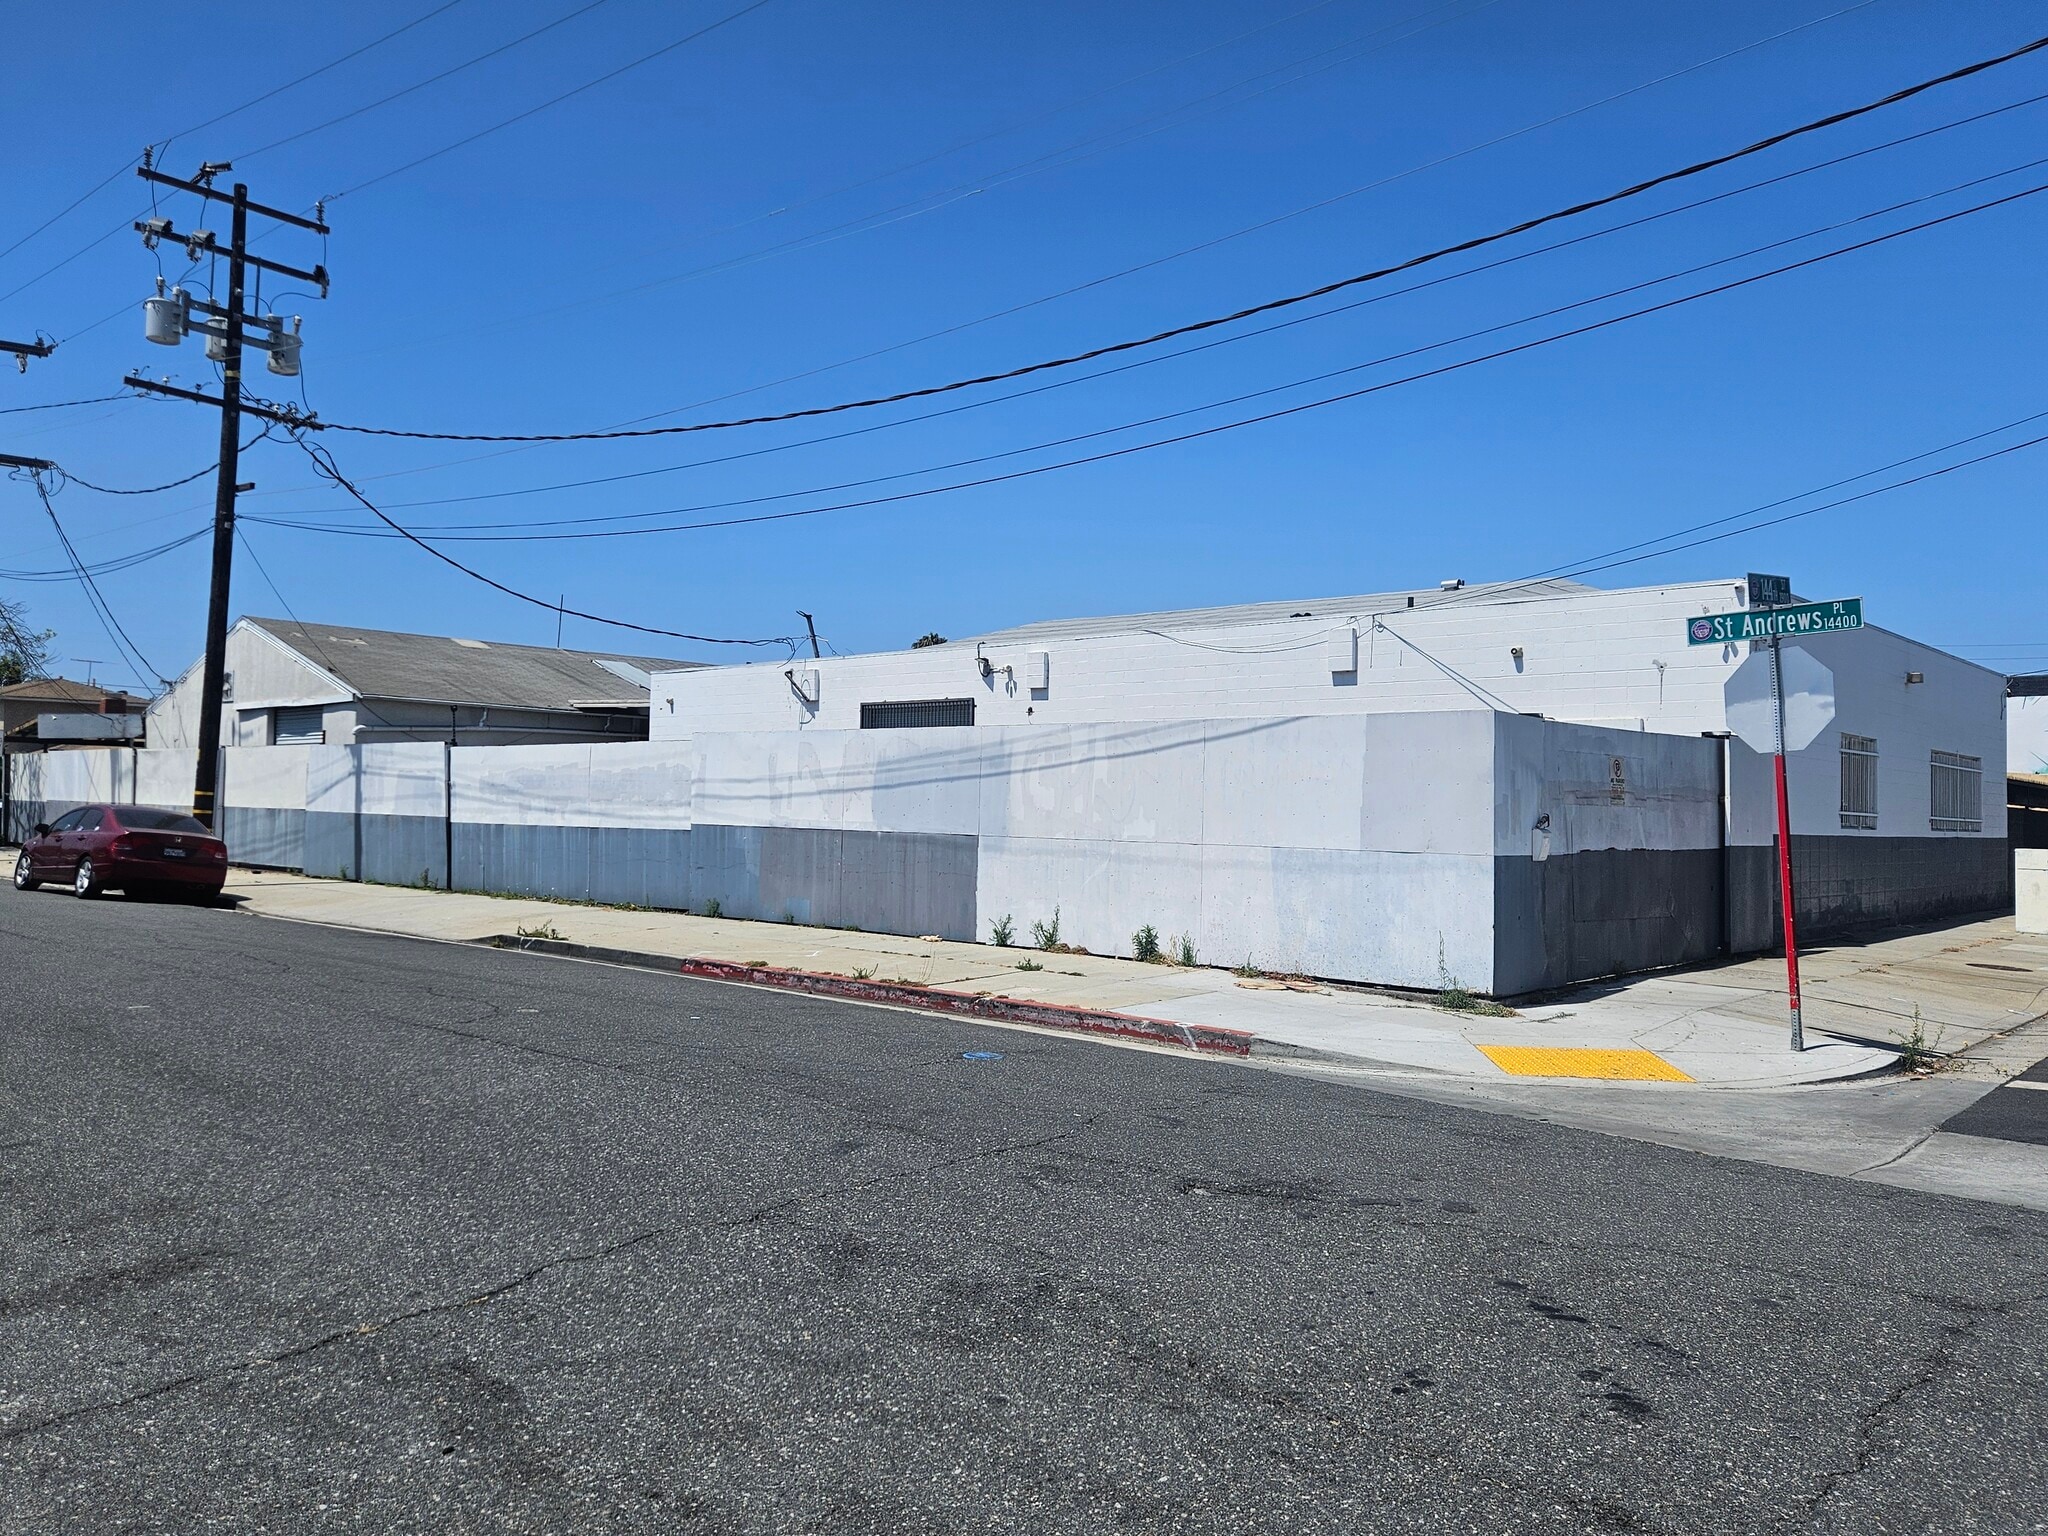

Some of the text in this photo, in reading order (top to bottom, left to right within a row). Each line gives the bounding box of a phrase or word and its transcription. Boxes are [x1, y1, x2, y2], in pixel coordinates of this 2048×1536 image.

[1833, 602, 1845, 614] PL
[1714, 618, 1733, 639] St
[1742, 612, 1822, 636] Andrews
[1824, 615, 1857, 630] 14400
